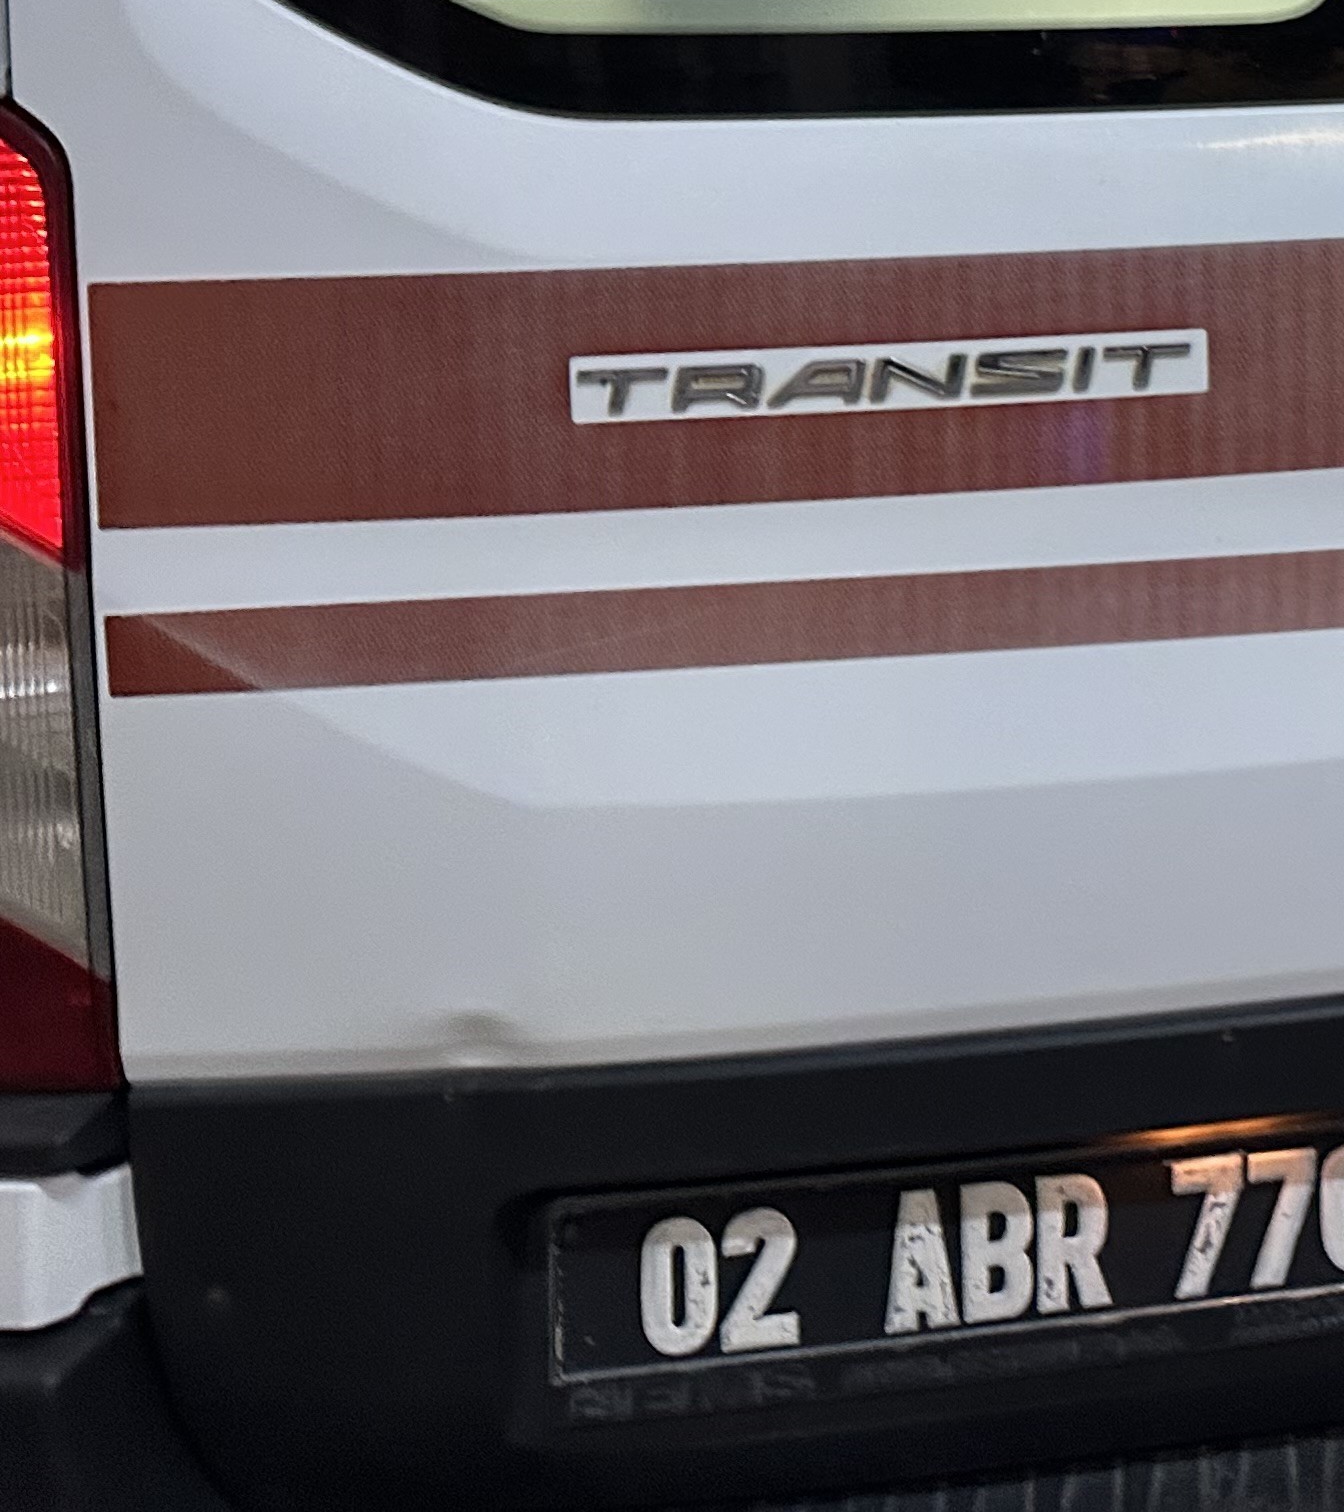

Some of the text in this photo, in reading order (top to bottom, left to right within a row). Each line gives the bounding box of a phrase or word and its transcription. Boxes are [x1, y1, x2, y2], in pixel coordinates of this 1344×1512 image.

[577, 343, 1191, 417] TRANSIT
[640, 1206, 800, 1356] 02
[884, 1172, 1113, 1335] ABR
